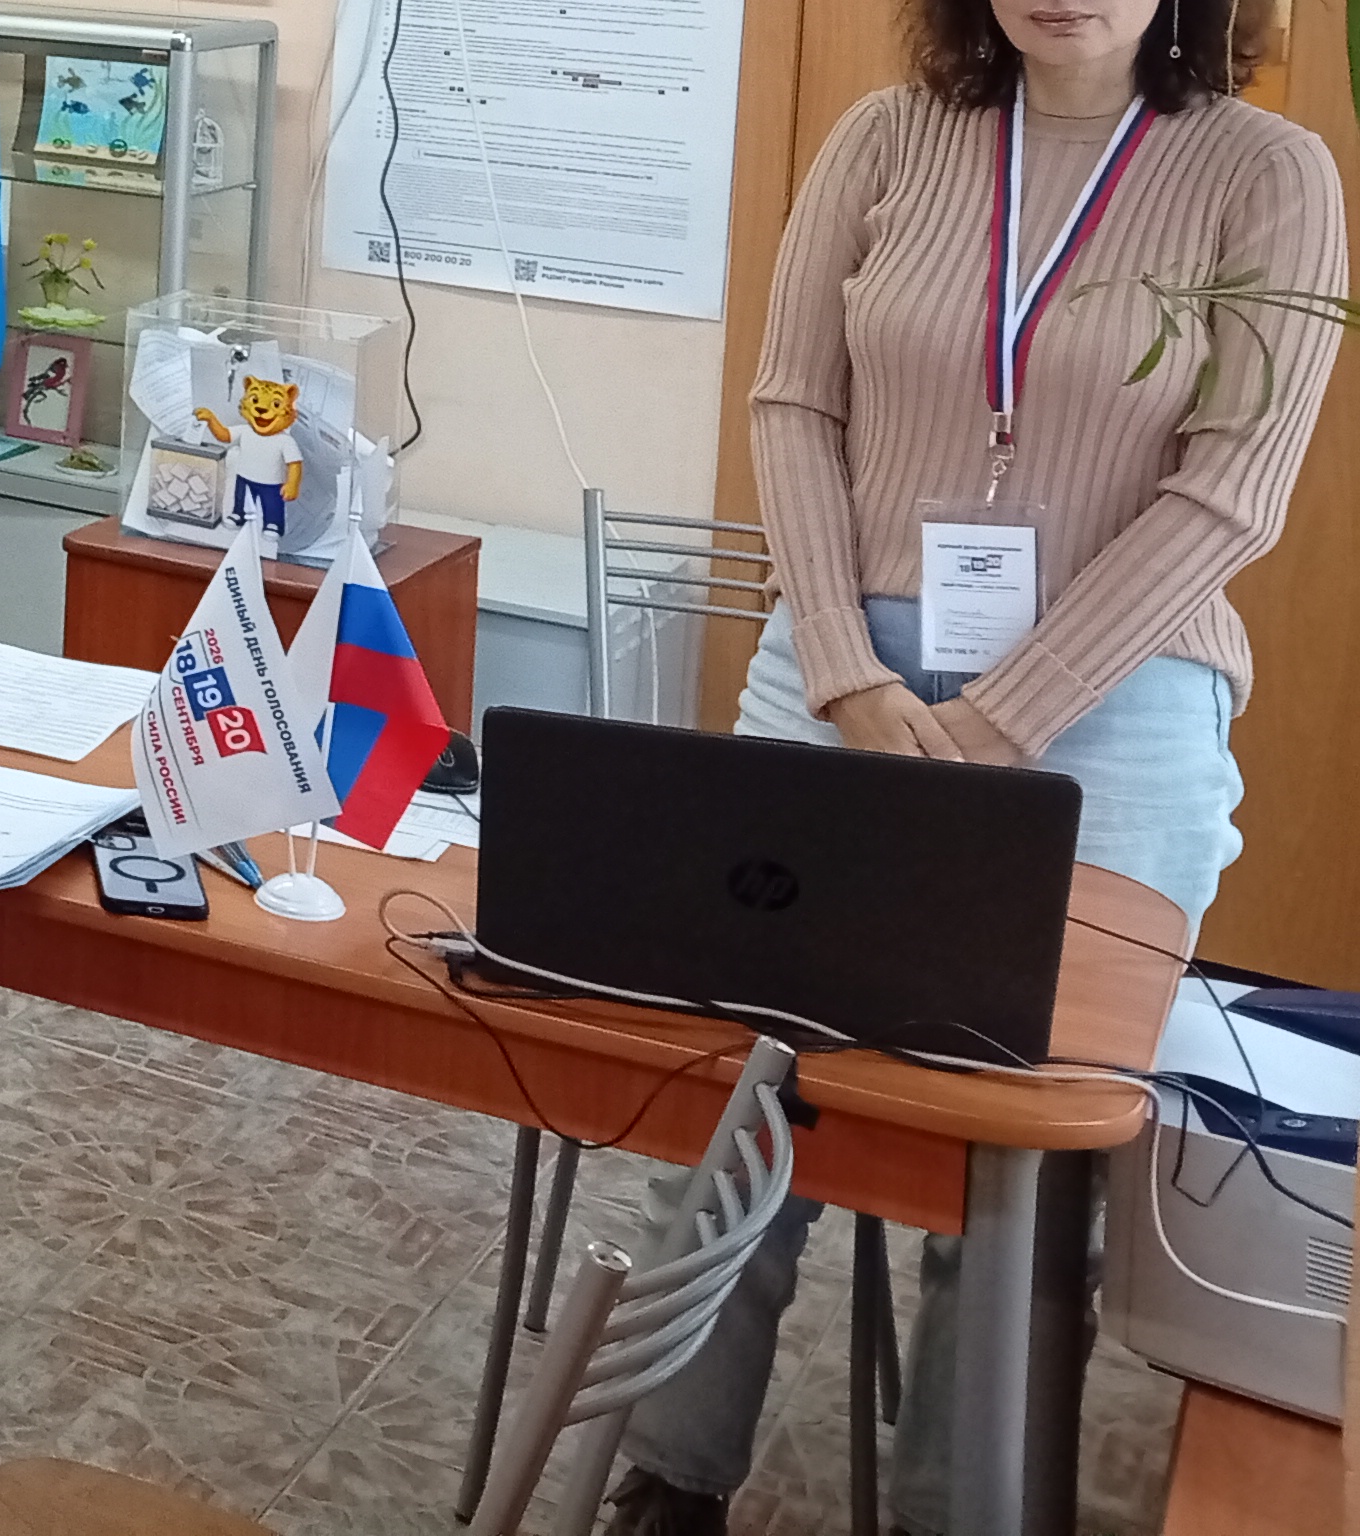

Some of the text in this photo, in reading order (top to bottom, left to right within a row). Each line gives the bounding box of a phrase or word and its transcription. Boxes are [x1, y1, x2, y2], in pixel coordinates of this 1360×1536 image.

[424, 253, 442, 263] 200
[444, 255, 458, 265] 00
[175, 639, 197, 674] 18
[204, 627, 224, 665] 2026
[192, 674, 222, 709] 19
[225, 566, 312, 794] ЕДИНЫЙ ДЕНЬ ГОЛОСОВАНИЯ
[171, 686, 205, 767] СЕНТЯБРЯ
[216, 710, 251, 750] 20
[147, 710, 187, 826] СИЛА РОССИИ!
[737, 860, 793, 910] hp
